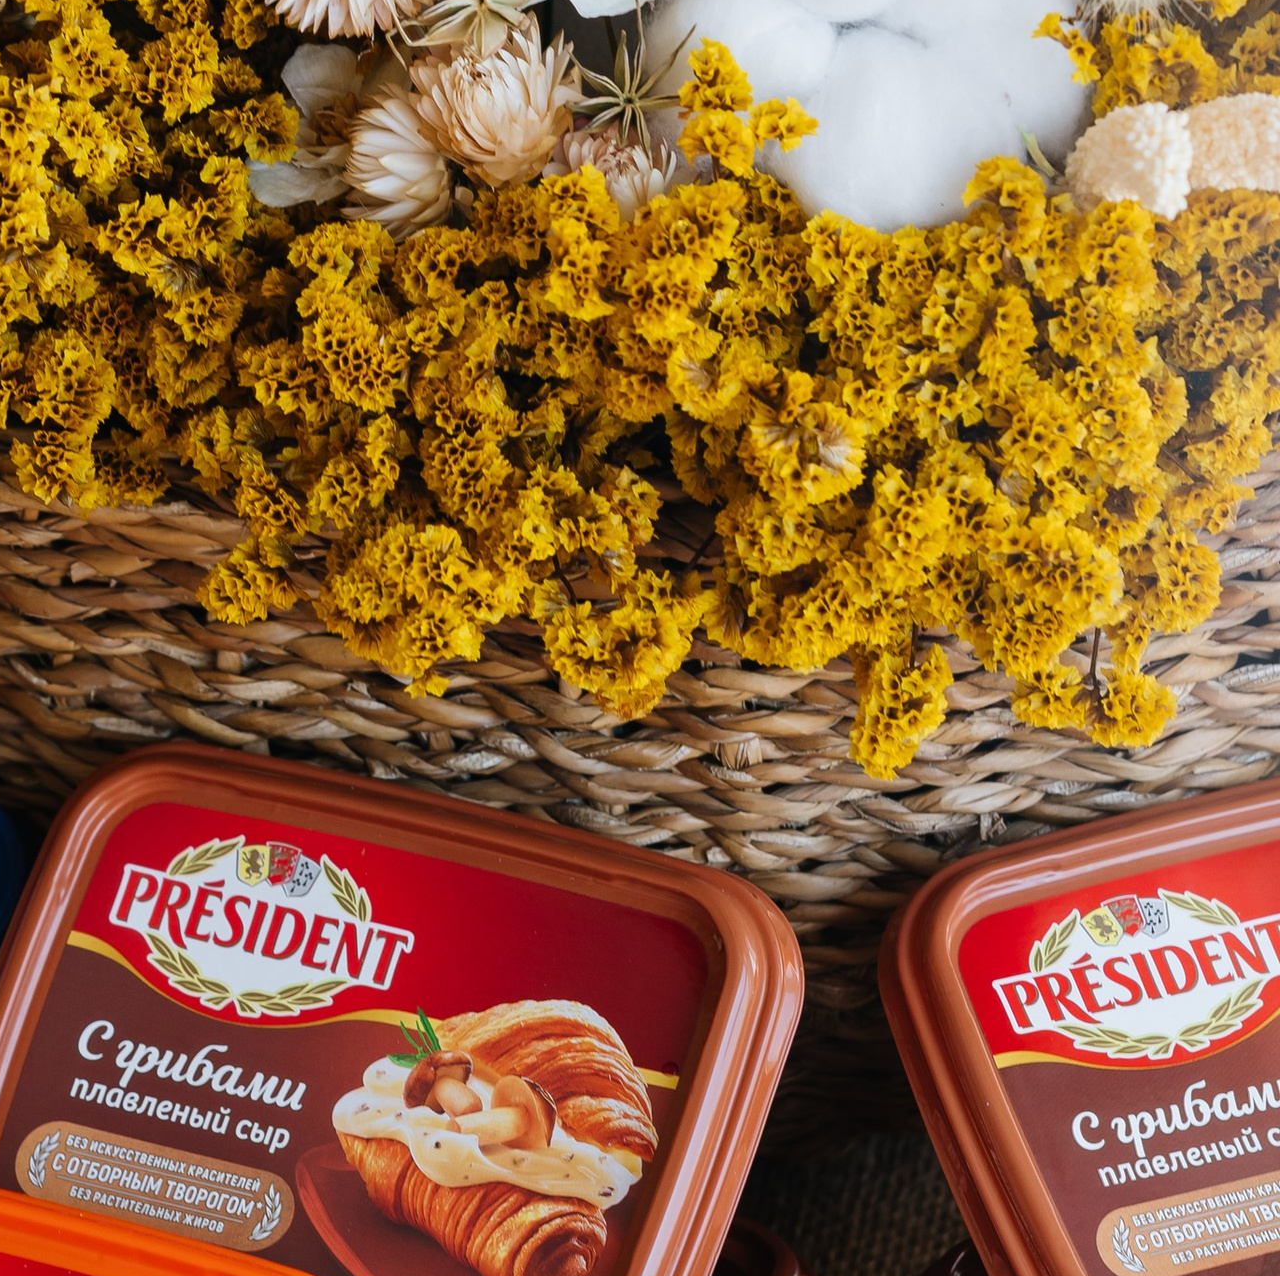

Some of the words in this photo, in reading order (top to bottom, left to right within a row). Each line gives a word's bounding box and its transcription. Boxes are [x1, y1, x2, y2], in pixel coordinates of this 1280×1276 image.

[115, 869, 410, 986] PRÉSIDENT
[1000, 920, 1280, 1028] PRÉSIDENT
[77, 1020, 115, 1060] С
[115, 1037, 307, 1111] грибами
[70, 1077, 230, 1134] плавленый
[235, 1116, 290, 1153] сыр
[1071, 1111, 1106, 1151] С
[1110, 1079, 1280, 1158] грибам
[52, 1153, 66, 1171] С
[66, 1157, 162, 1195] ОТБОРНЫМ
[65, 1134, 87, 1149] БЕЗ
[90, 1140, 186, 1174] ИСКУССТВЕННЫХ
[187, 1164, 261, 1192] КРАСИТЕЛЕЙ
[1097, 1127, 1263, 1187] плавленый
[70, 1185, 91, 1200] БЕЗ
[92, 1191, 183, 1224] РАСТИТЕЛЬНЫХ
[183, 1212, 225, 1233] ЖИРОВ
[1132, 1213, 1155, 1227] БЕЗ
[1156, 1187, 1256, 1222] ИСКУССТВЕННЫХ
[1134, 1235, 1149, 1252] С
[1149, 1210, 1249, 1249] ОТБОРНЫМ
[1171, 1251, 1195, 1265] БЕЗ
